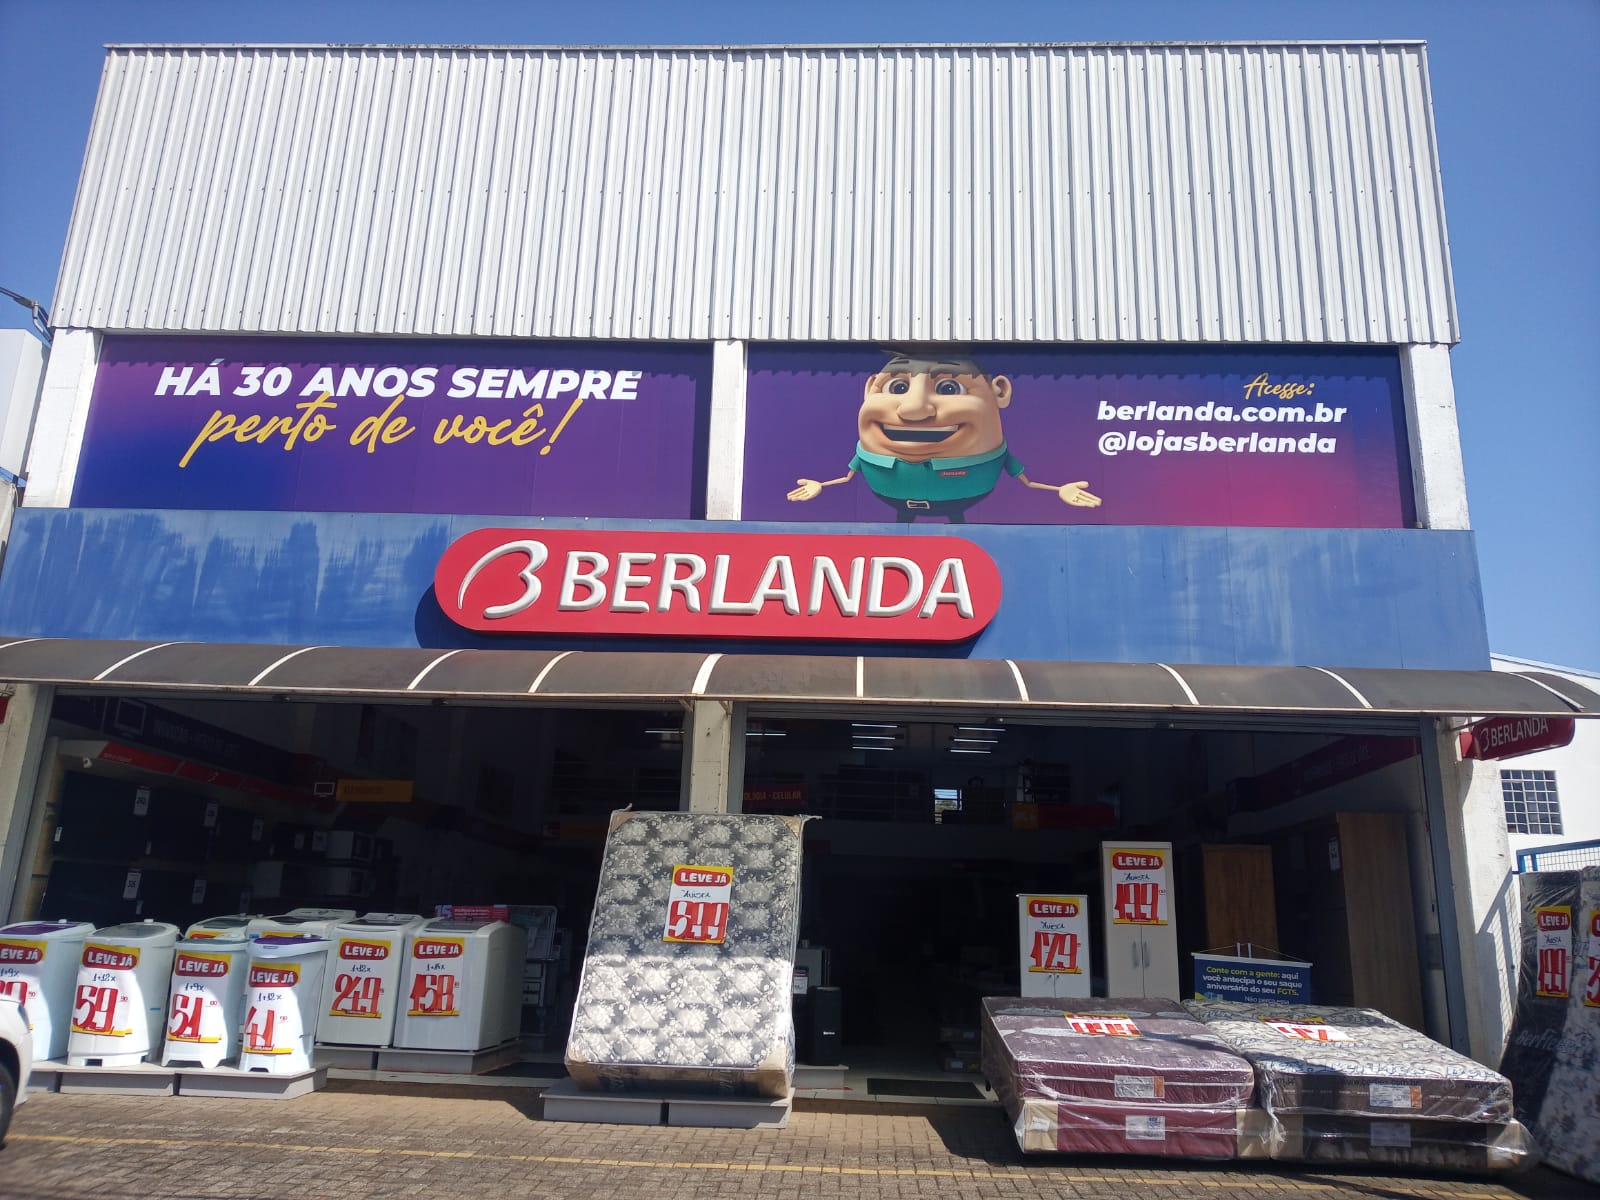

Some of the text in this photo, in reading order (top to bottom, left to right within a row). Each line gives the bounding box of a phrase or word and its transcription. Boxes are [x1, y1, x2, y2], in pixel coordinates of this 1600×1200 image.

[154, 358, 642, 400] HÁ 30 ANOS SEMPRE
[1243, 373, 1315, 400] Acesse:
[1097, 400, 1347, 423] berlanda.com.br
[179, 390, 583, 468] perto de você!
[1098, 430, 1337, 456] @lojasberlanda
[557, 550, 975, 619] BERLANDA
[1490, 717, 1549, 747] BERLANDA
[1118, 855, 1160, 866] LEVE JÁ
[680, 872, 727, 883] LEVE JÁ
[1034, 903, 1076, 914] LEVE JÁ
[668, 900, 729, 940] 599
[1541, 914, 1560, 927] LEVE
[25, 948, 39, 960] JÁ
[344, 945, 385, 957] LEVE JÁ
[418, 944, 460, 955] LEVE JÁ
[1030, 931, 1078, 971] 179
[87, 951, 133, 967] LEVE JÁ
[178, 959, 225, 973] LEVE JÁ
[250, 971, 295, 984] LEVE JÁ
[1206, 966, 1230, 974] Conte
[1282, 972, 1299, 980] aqui
[1202, 974, 1222, 982] você
[1222, 975, 1256, 985] antecipa
[1279, 981, 1303, 989] saque
[1206, 983, 1249, 992] aniversário
[1250, 985, 1261, 993] do
[331, 973, 382, 1014] 249
[410, 973, 455, 1012] 158
[72, 985, 119, 1033] 59
